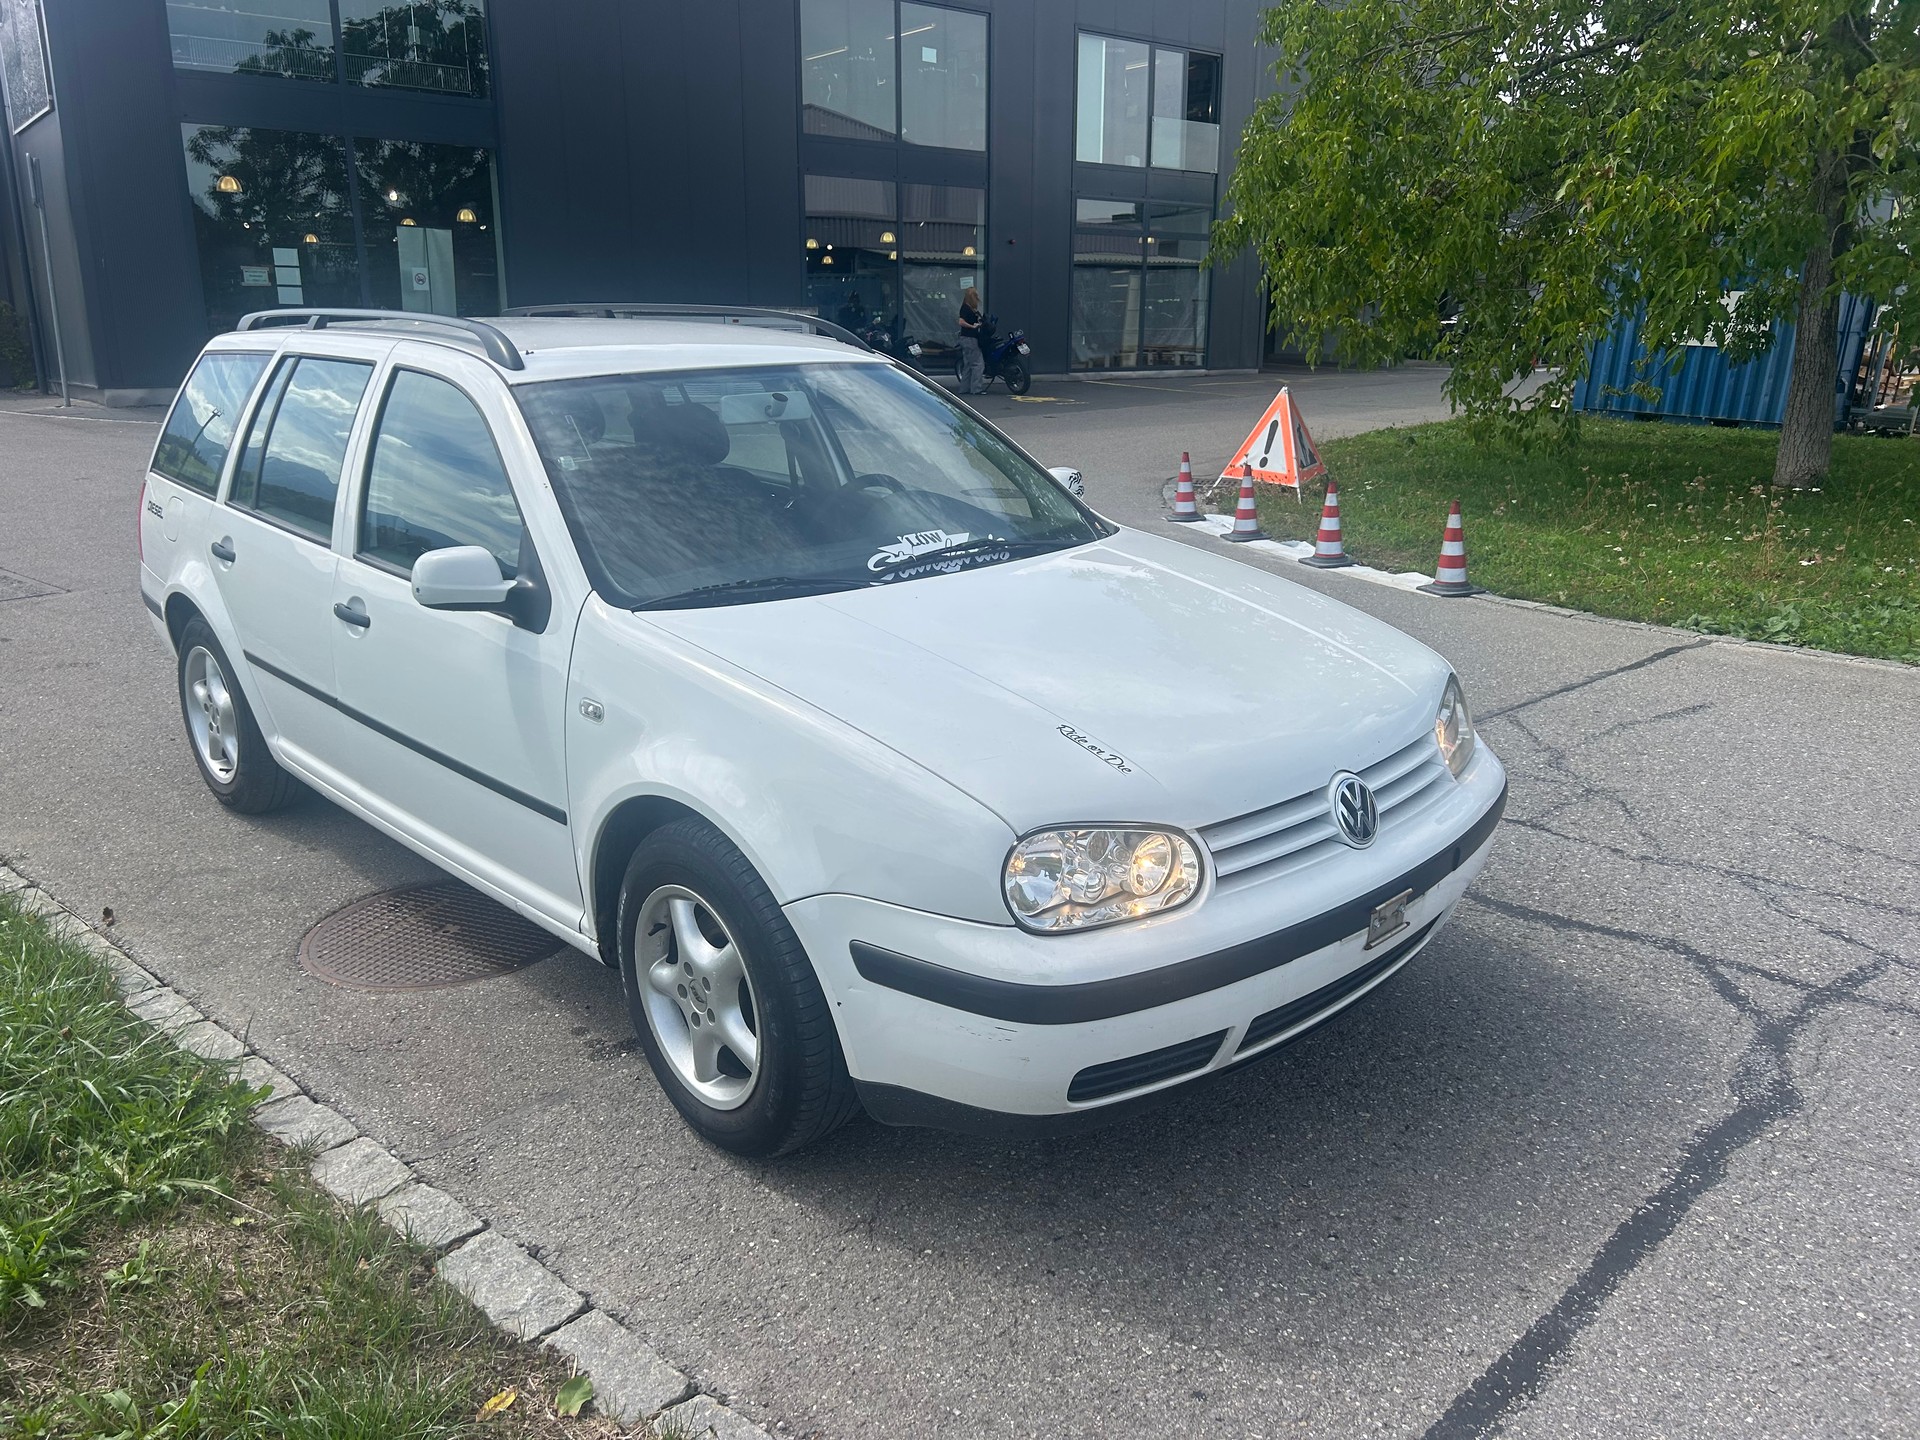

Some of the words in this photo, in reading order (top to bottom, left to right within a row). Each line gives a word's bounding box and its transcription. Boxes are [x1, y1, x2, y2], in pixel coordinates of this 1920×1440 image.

[904, 531, 943, 547] LOW
[1056, 724, 1089, 744] Ride
[1087, 744, 1106, 756] or
[1103, 754, 1132, 775] Die
[1338, 780, 1378, 842] VW
